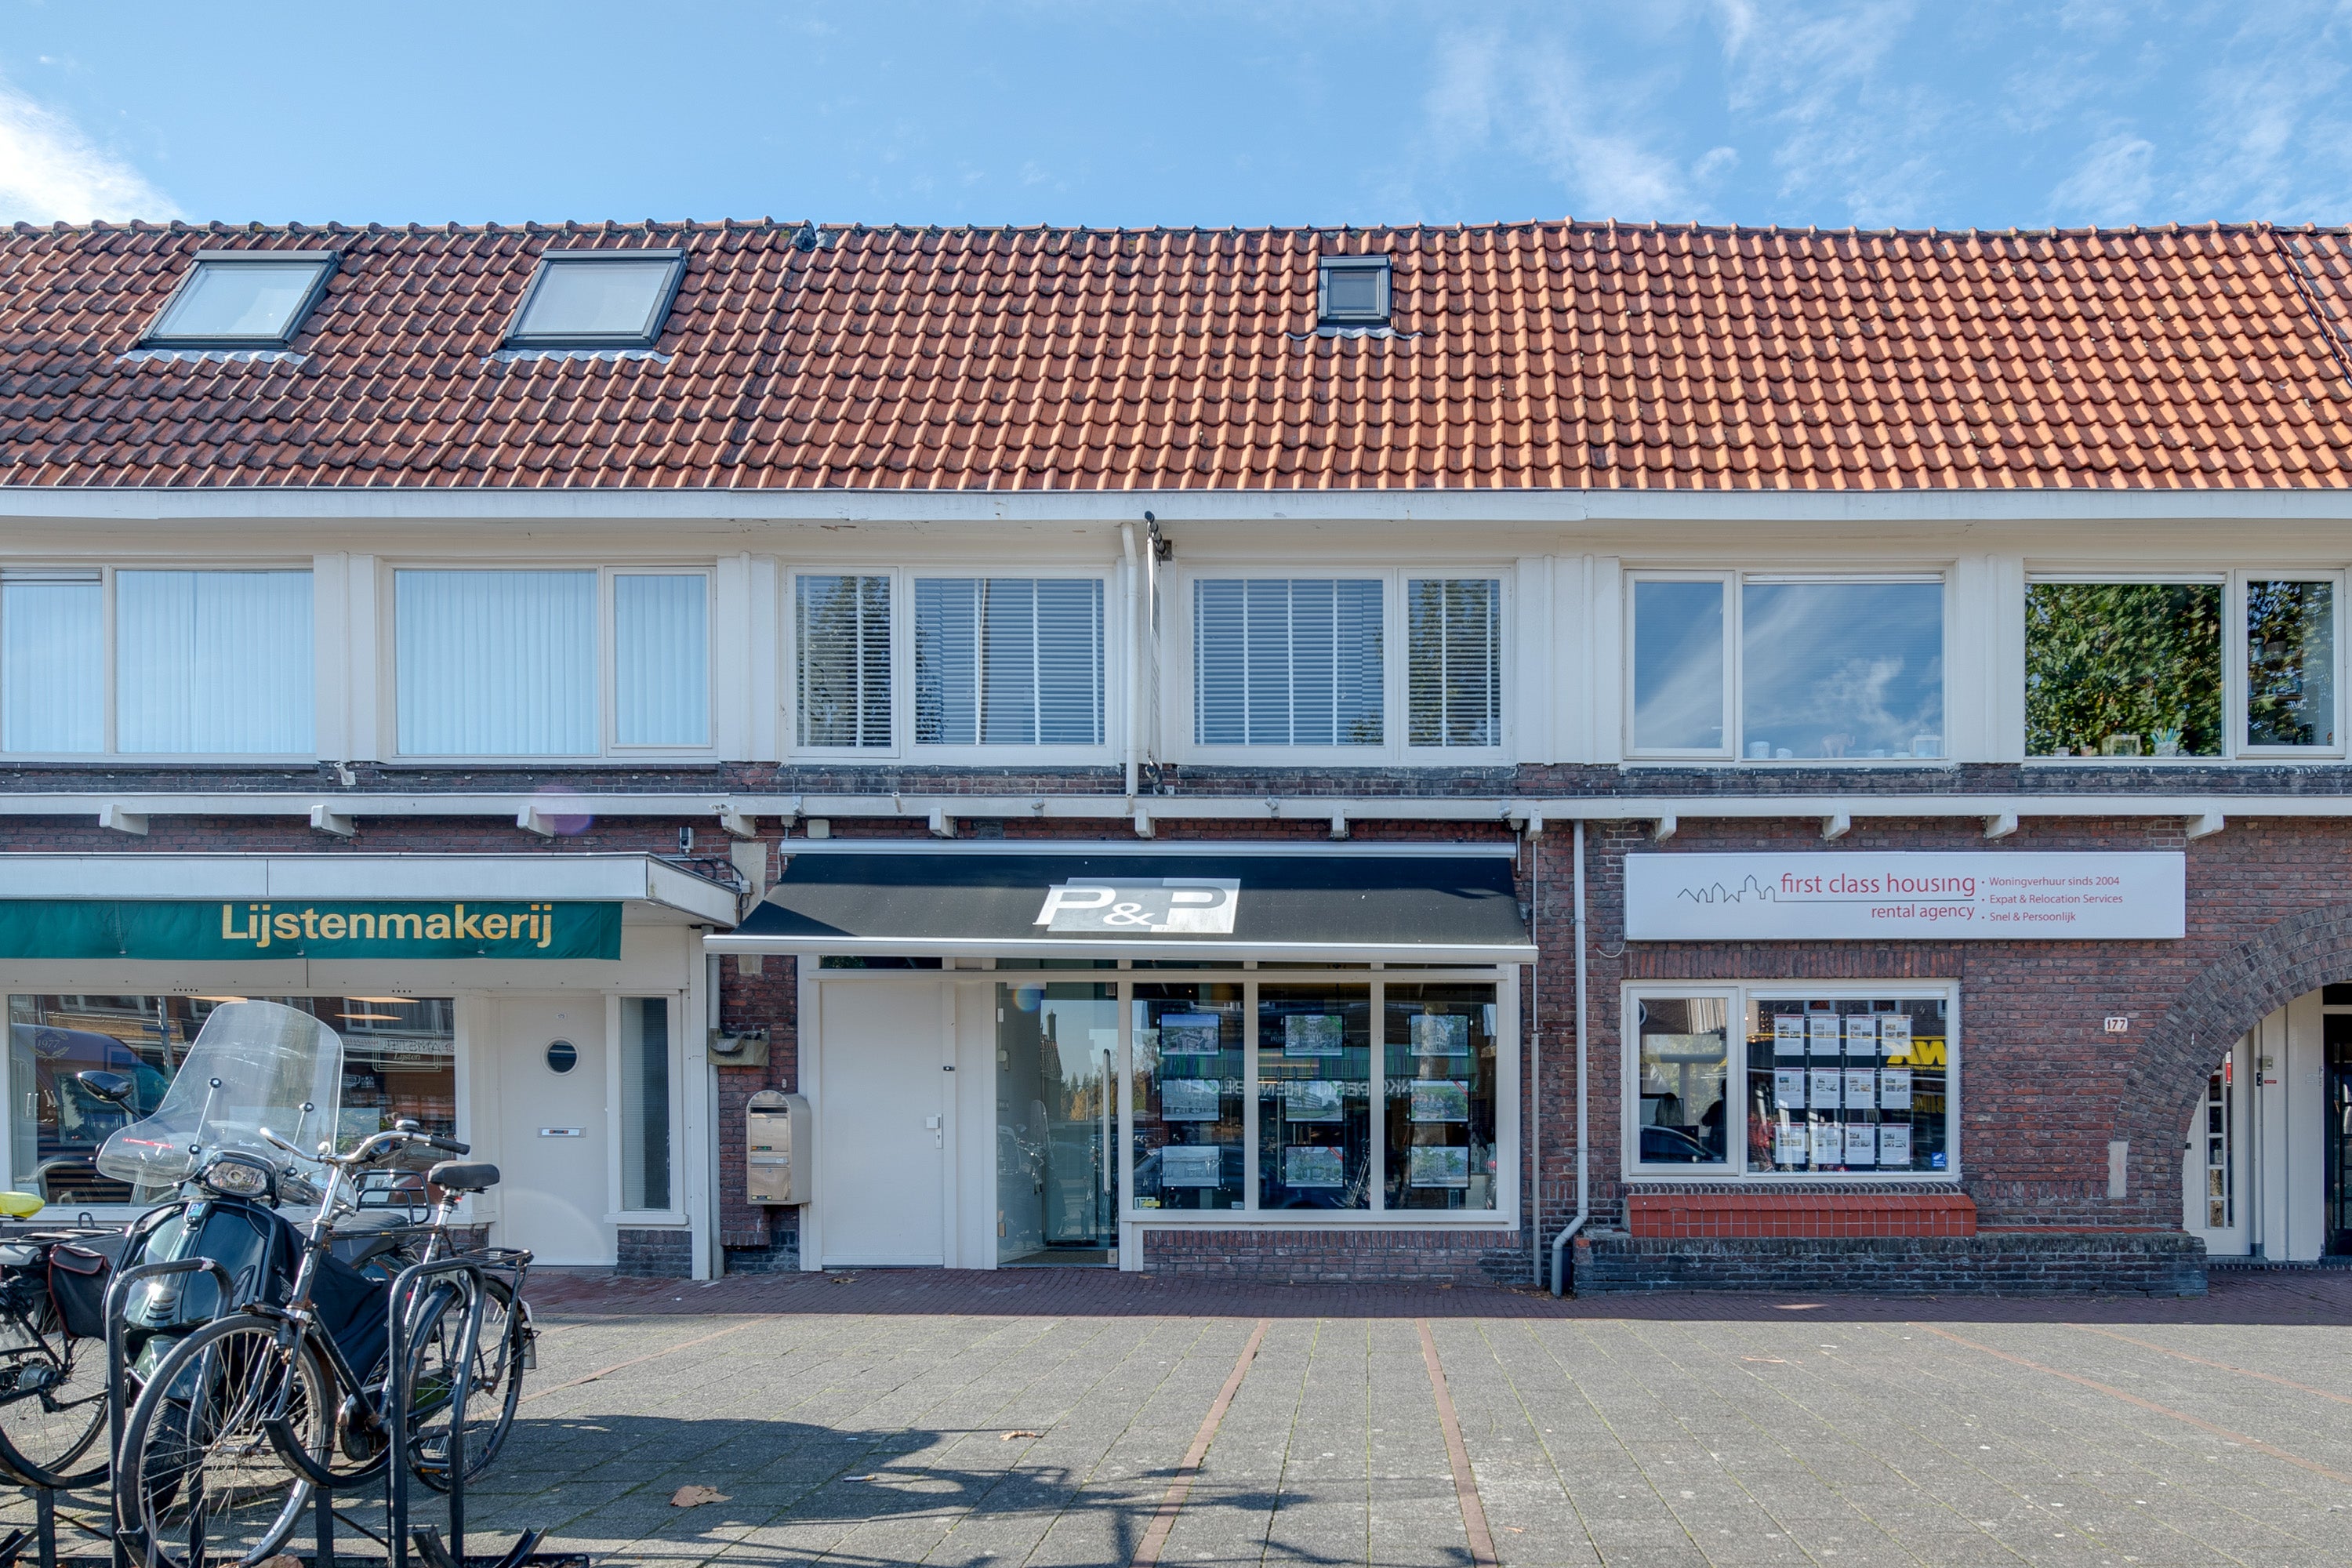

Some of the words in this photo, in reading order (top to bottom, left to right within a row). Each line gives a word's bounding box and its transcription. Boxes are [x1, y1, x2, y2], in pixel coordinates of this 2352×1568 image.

[1780, 873, 1823, 893] first
[1828, 873, 1880, 893] class
[1886, 873, 1976, 897] housing
[1989, 877, 2066, 888] Woningverhuur
[2068, 877, 2093, 886] sinds
[2096, 877, 2120, 886] 2004
[1032, 884, 1228, 927] P&P
[1989, 894, 2017, 906] Expat
[2020, 894, 2027, 903] &
[2029, 894, 2081, 903] Relocation
[2083, 894, 2123, 903] Services
[1871, 903, 1915, 918] rental
[1919, 906, 1975, 921] agency
[1989, 912, 2011, 921] Snel
[2013, 912, 2020, 921] &
[2023, 912, 2076, 923] Persoonlijk
[222, 903, 553, 949] Lijstenmakerij
[2107, 1019, 2126, 1029] 177
[37, 1039, 60, 1049] 1977
